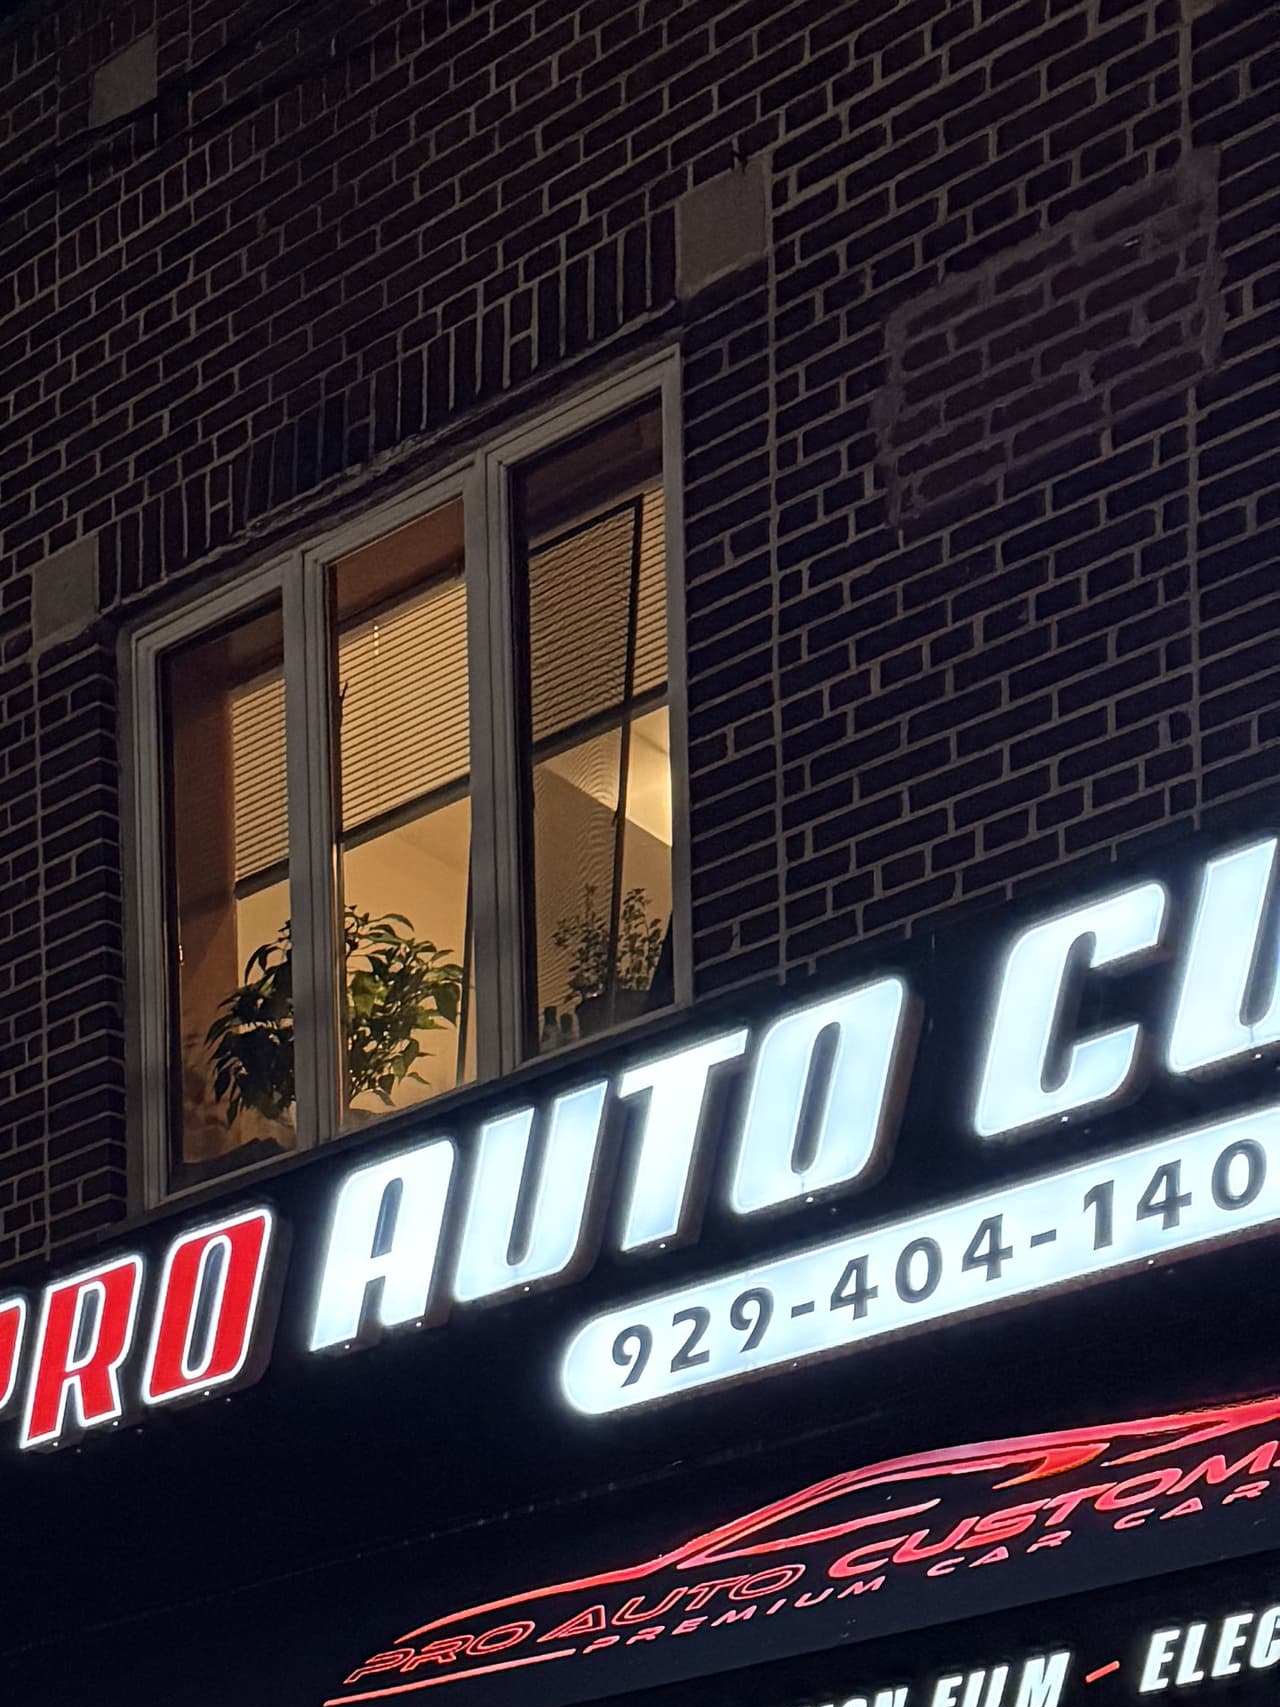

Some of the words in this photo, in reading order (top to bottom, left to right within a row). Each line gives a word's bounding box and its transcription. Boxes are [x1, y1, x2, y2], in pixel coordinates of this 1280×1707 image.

[308, 976, 907, 1352] AUTO
[609, 1138, 1269, 1389] 929-404-140
[343, 1620, 536, 1684] PRO
[537, 1563, 807, 1643] AUTO
[826, 1440, 1280, 1579] CUSTOM
[582, 1574, 887, 1655] PREMIUM
[925, 1529, 1073, 1578] CAR
[1112, 1480, 1271, 1531] CAR
[1138, 1605, 1280, 1694] ELEC
